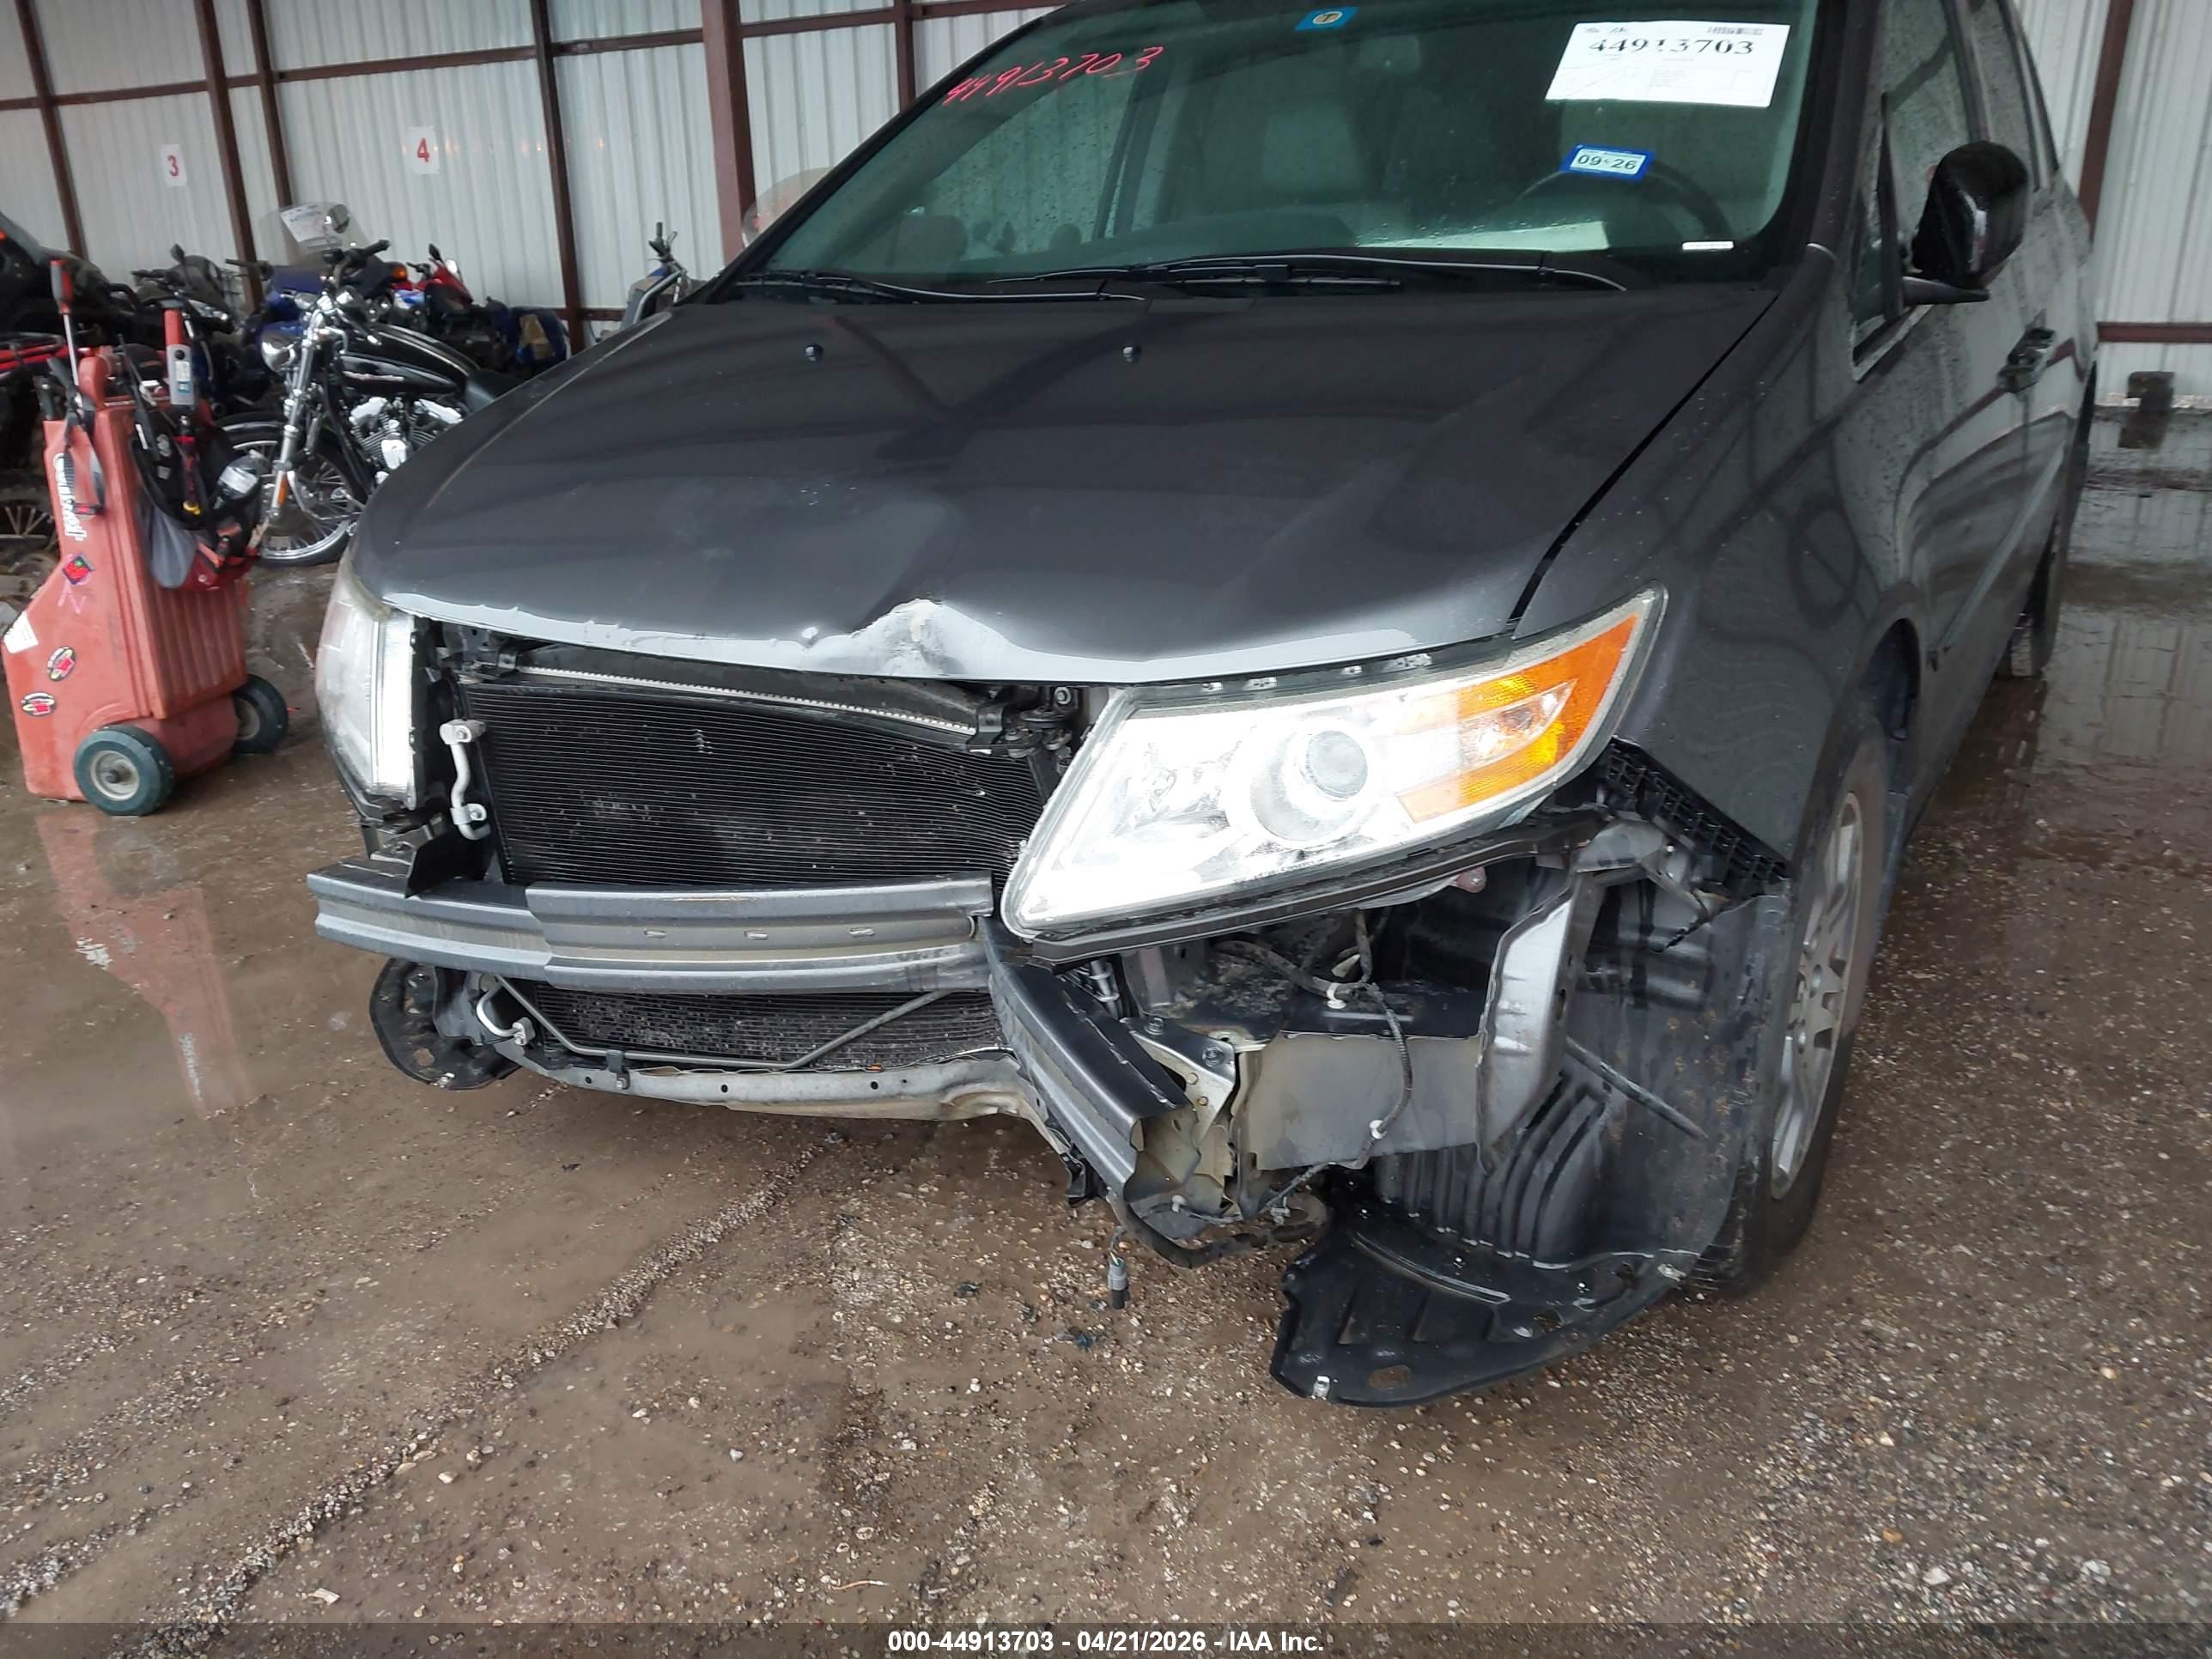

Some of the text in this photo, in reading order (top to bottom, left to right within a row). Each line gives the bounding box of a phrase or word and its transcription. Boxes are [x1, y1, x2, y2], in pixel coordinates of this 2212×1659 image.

[1588, 38, 1755, 55] 44913703
[416, 137, 430, 163] 4
[167, 155, 180, 178] 3
